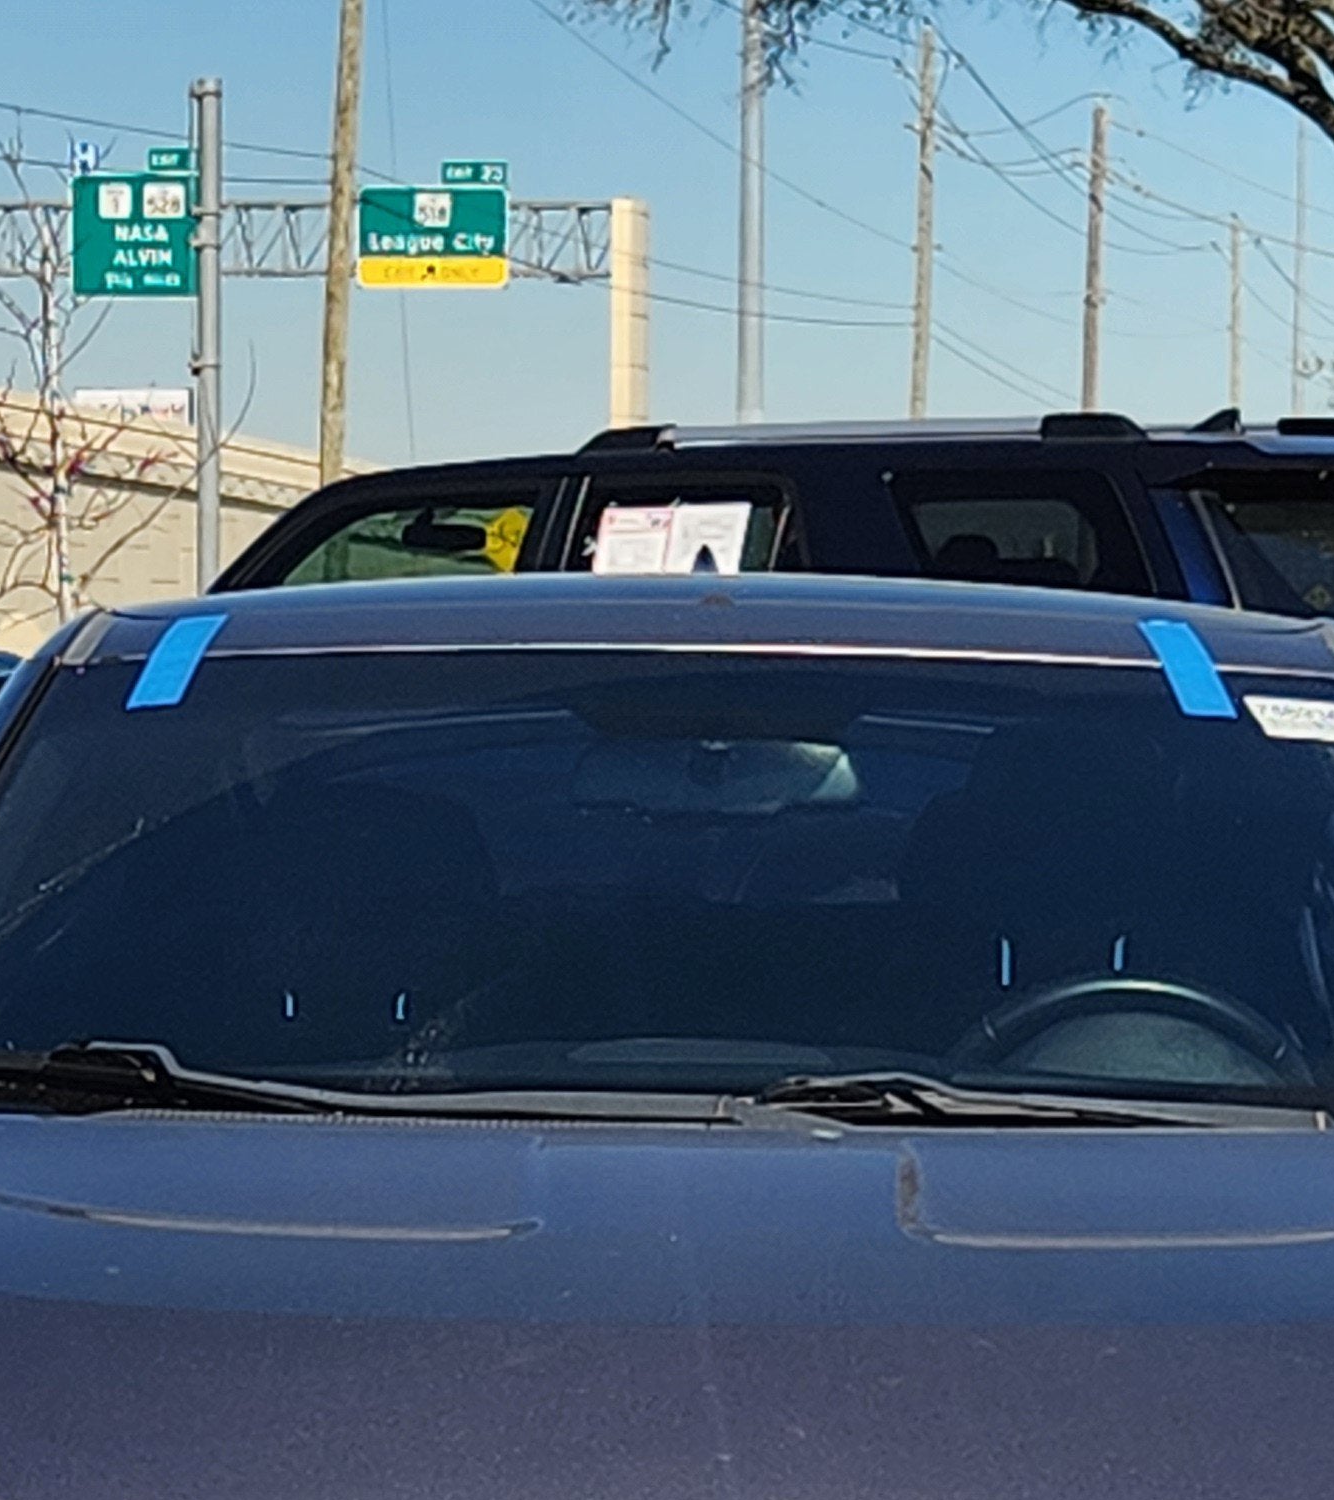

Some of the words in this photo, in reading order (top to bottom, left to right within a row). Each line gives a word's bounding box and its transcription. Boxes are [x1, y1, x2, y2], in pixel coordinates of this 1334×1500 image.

[114, 223, 170, 243] NASA
[368, 231, 445, 255] League
[452, 231, 495, 256] City
[112, 249, 173, 267] ALVIN
